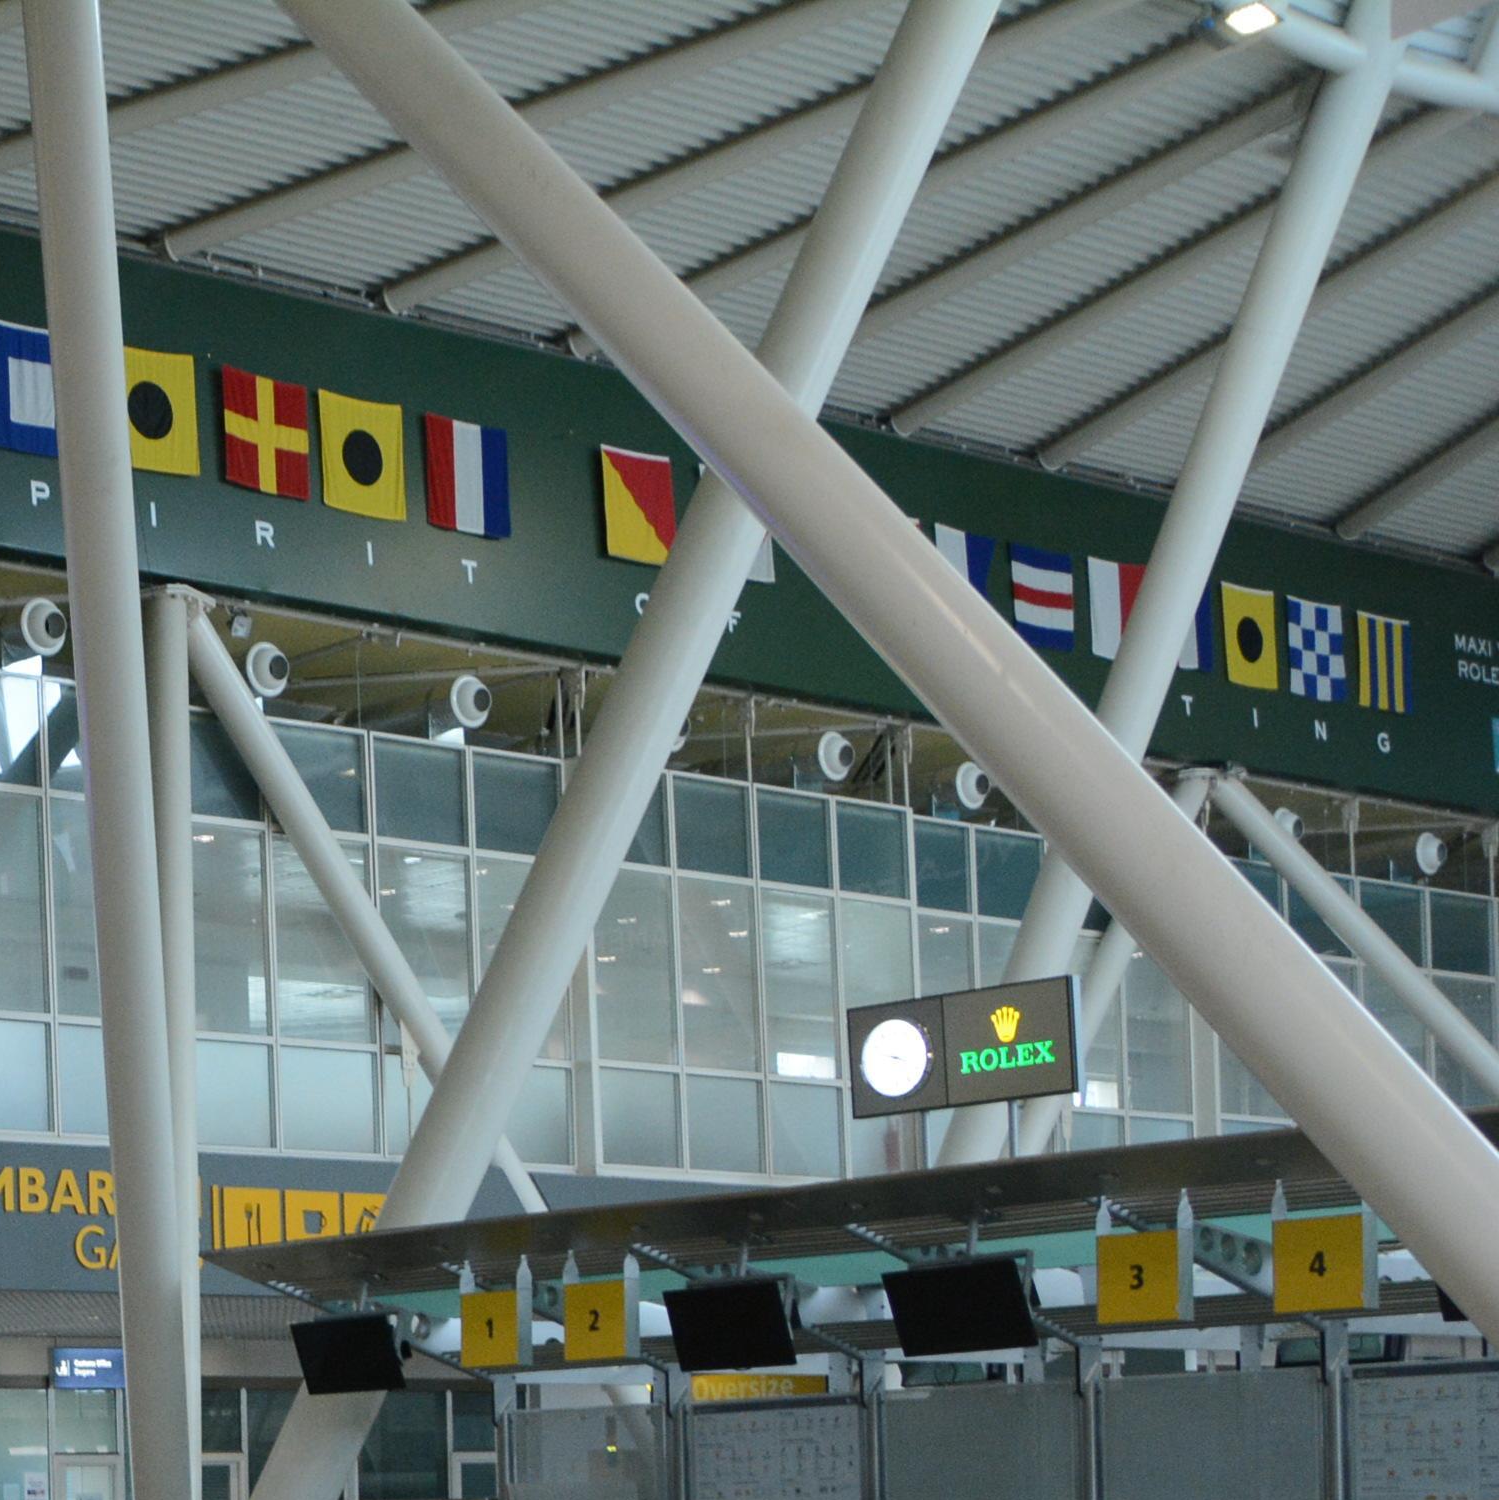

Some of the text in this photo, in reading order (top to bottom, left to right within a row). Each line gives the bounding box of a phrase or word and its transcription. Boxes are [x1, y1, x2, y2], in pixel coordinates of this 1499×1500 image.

[1453, 631, 1492, 658] MAXI
[960, 1039, 1055, 1075] ROLEX
[1129, 1264, 1145, 1290] 3
[1308, 1250, 1328, 1278] 4
[485, 1317, 494, 1339] 1
[588, 1309, 600, 1332] 2
[693, 1376, 795, 1400] Oversize
